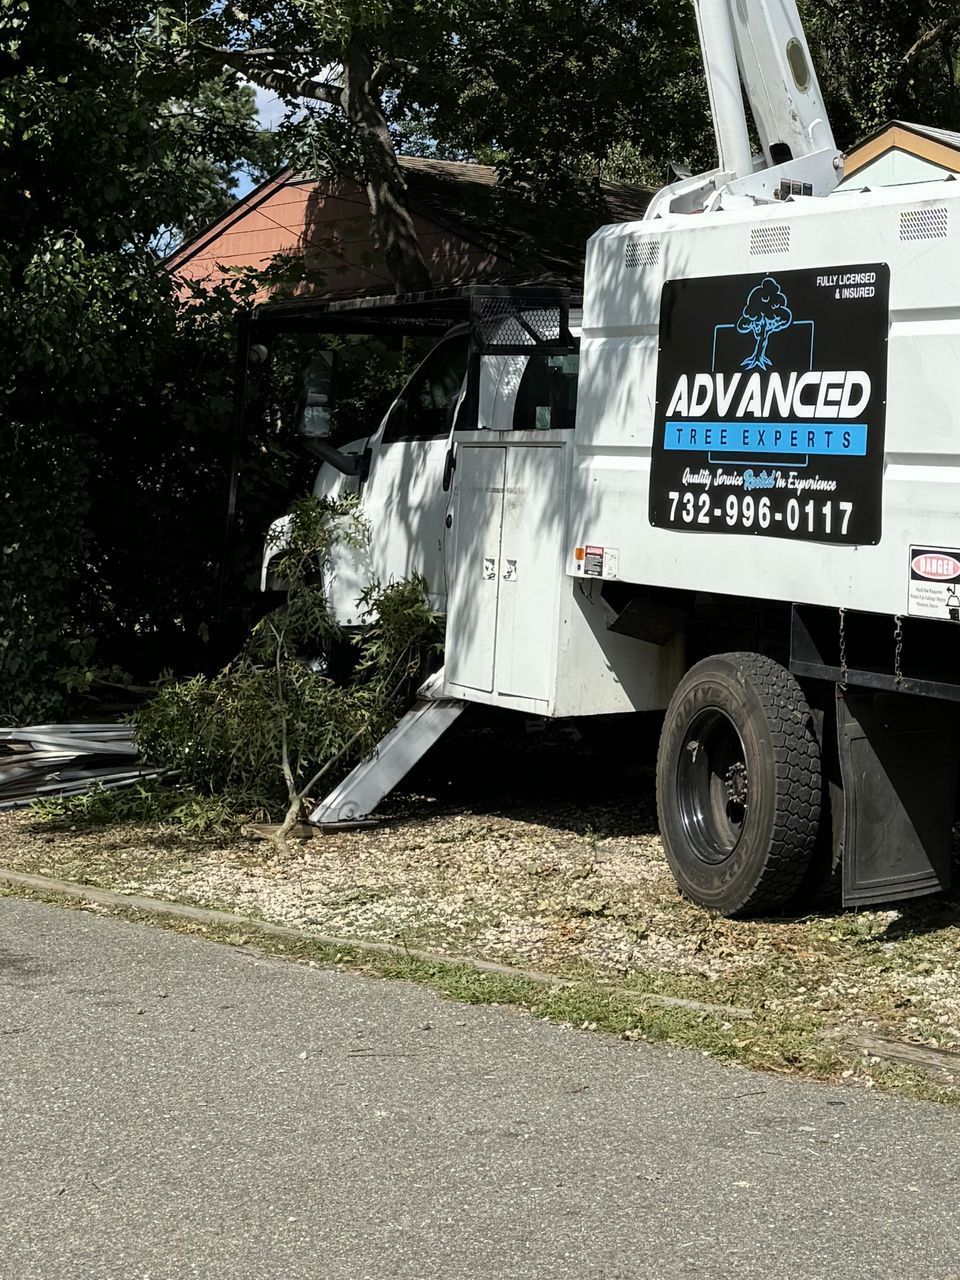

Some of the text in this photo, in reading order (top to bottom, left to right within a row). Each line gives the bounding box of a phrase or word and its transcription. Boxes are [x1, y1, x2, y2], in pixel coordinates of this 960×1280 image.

[816, 272, 876, 287] FULLY LICENSED
[835, 286, 875, 299] & INSURED
[665, 370, 872, 419] ADVANCED
[676, 428, 852, 449] TREE EXPERTS
[682, 467, 837, 496] Quality Service Rooted In Experience
[668, 491, 853, 535] 732-996-0117
[919, 558, 954, 575] DANGER
